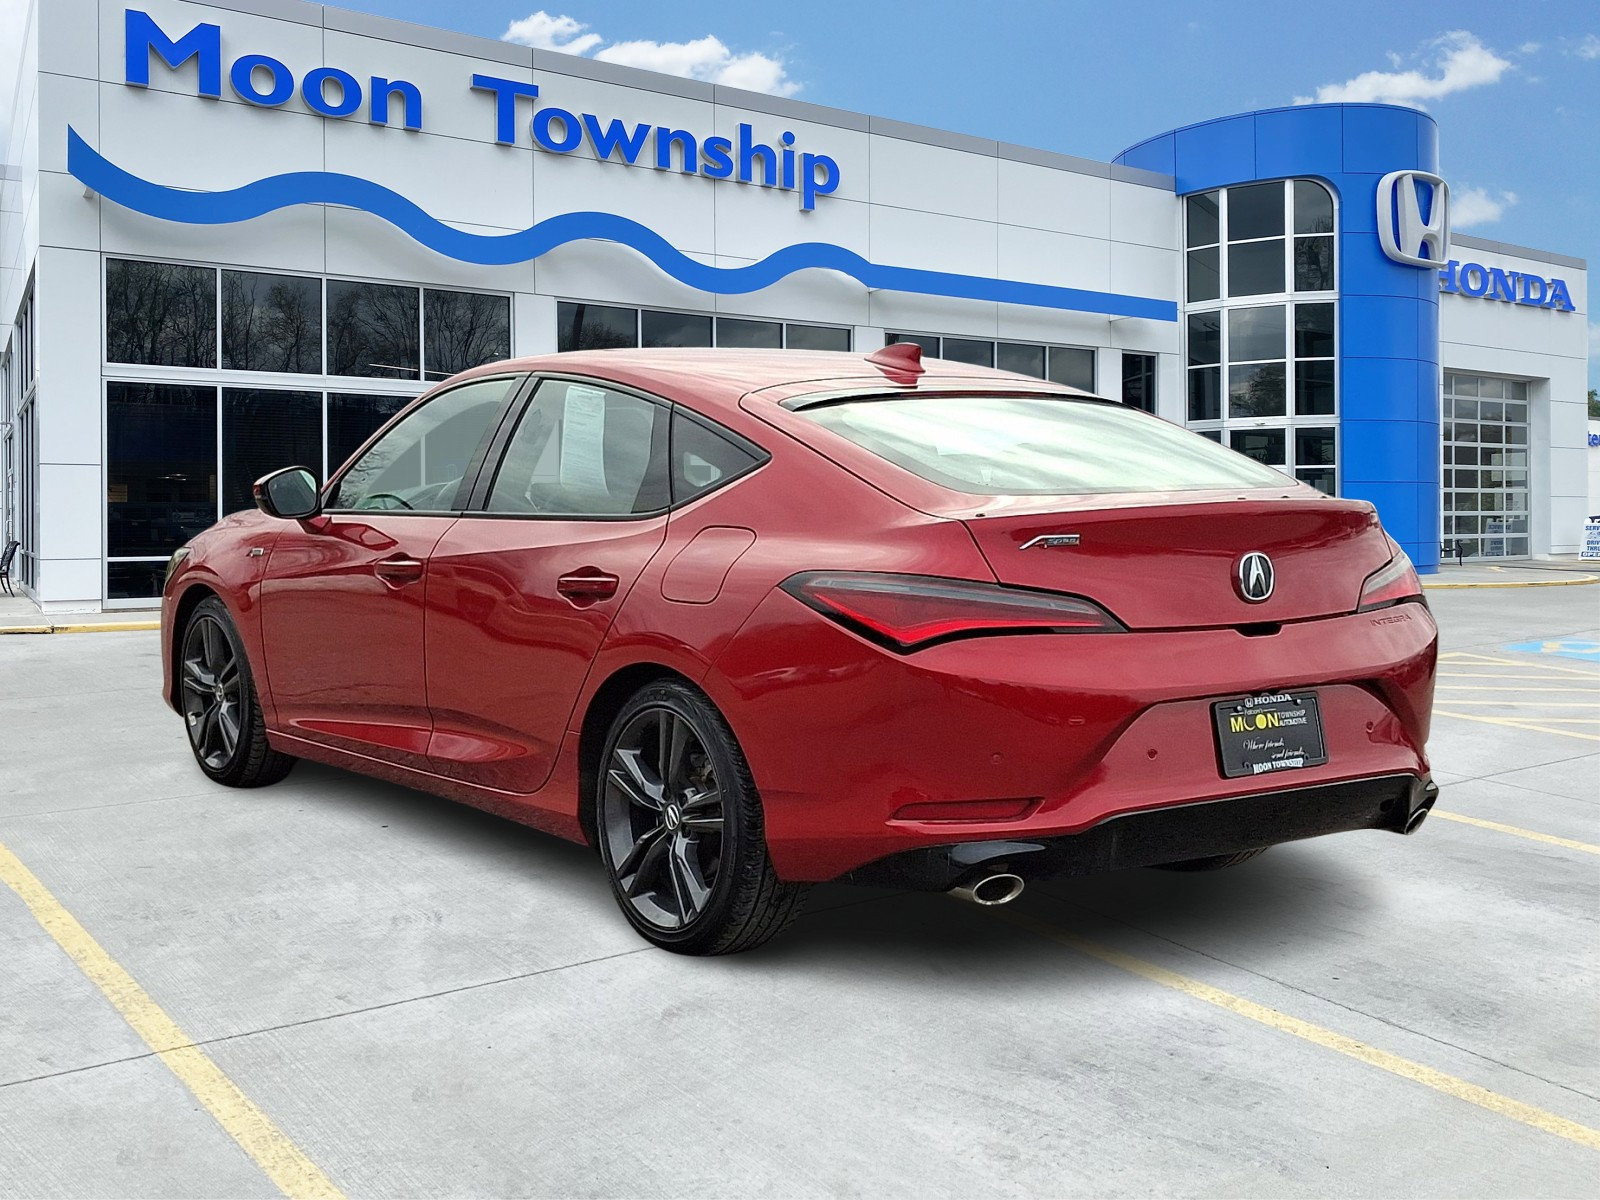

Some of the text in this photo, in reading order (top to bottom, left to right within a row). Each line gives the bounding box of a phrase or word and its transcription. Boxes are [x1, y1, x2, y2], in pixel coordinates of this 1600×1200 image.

[125, 9, 839, 211] Moon Township
[1370, 614, 1412, 626] INTEGRA
[1254, 694, 1292, 705] HONDA
[1278, 709, 1306, 719] TOWNSHIP
[1230, 712, 1279, 733] MOON
[1279, 717, 1307, 727] AUTOMOTIVE
[1253, 758, 1304, 774] MOON TOWNSHIP
